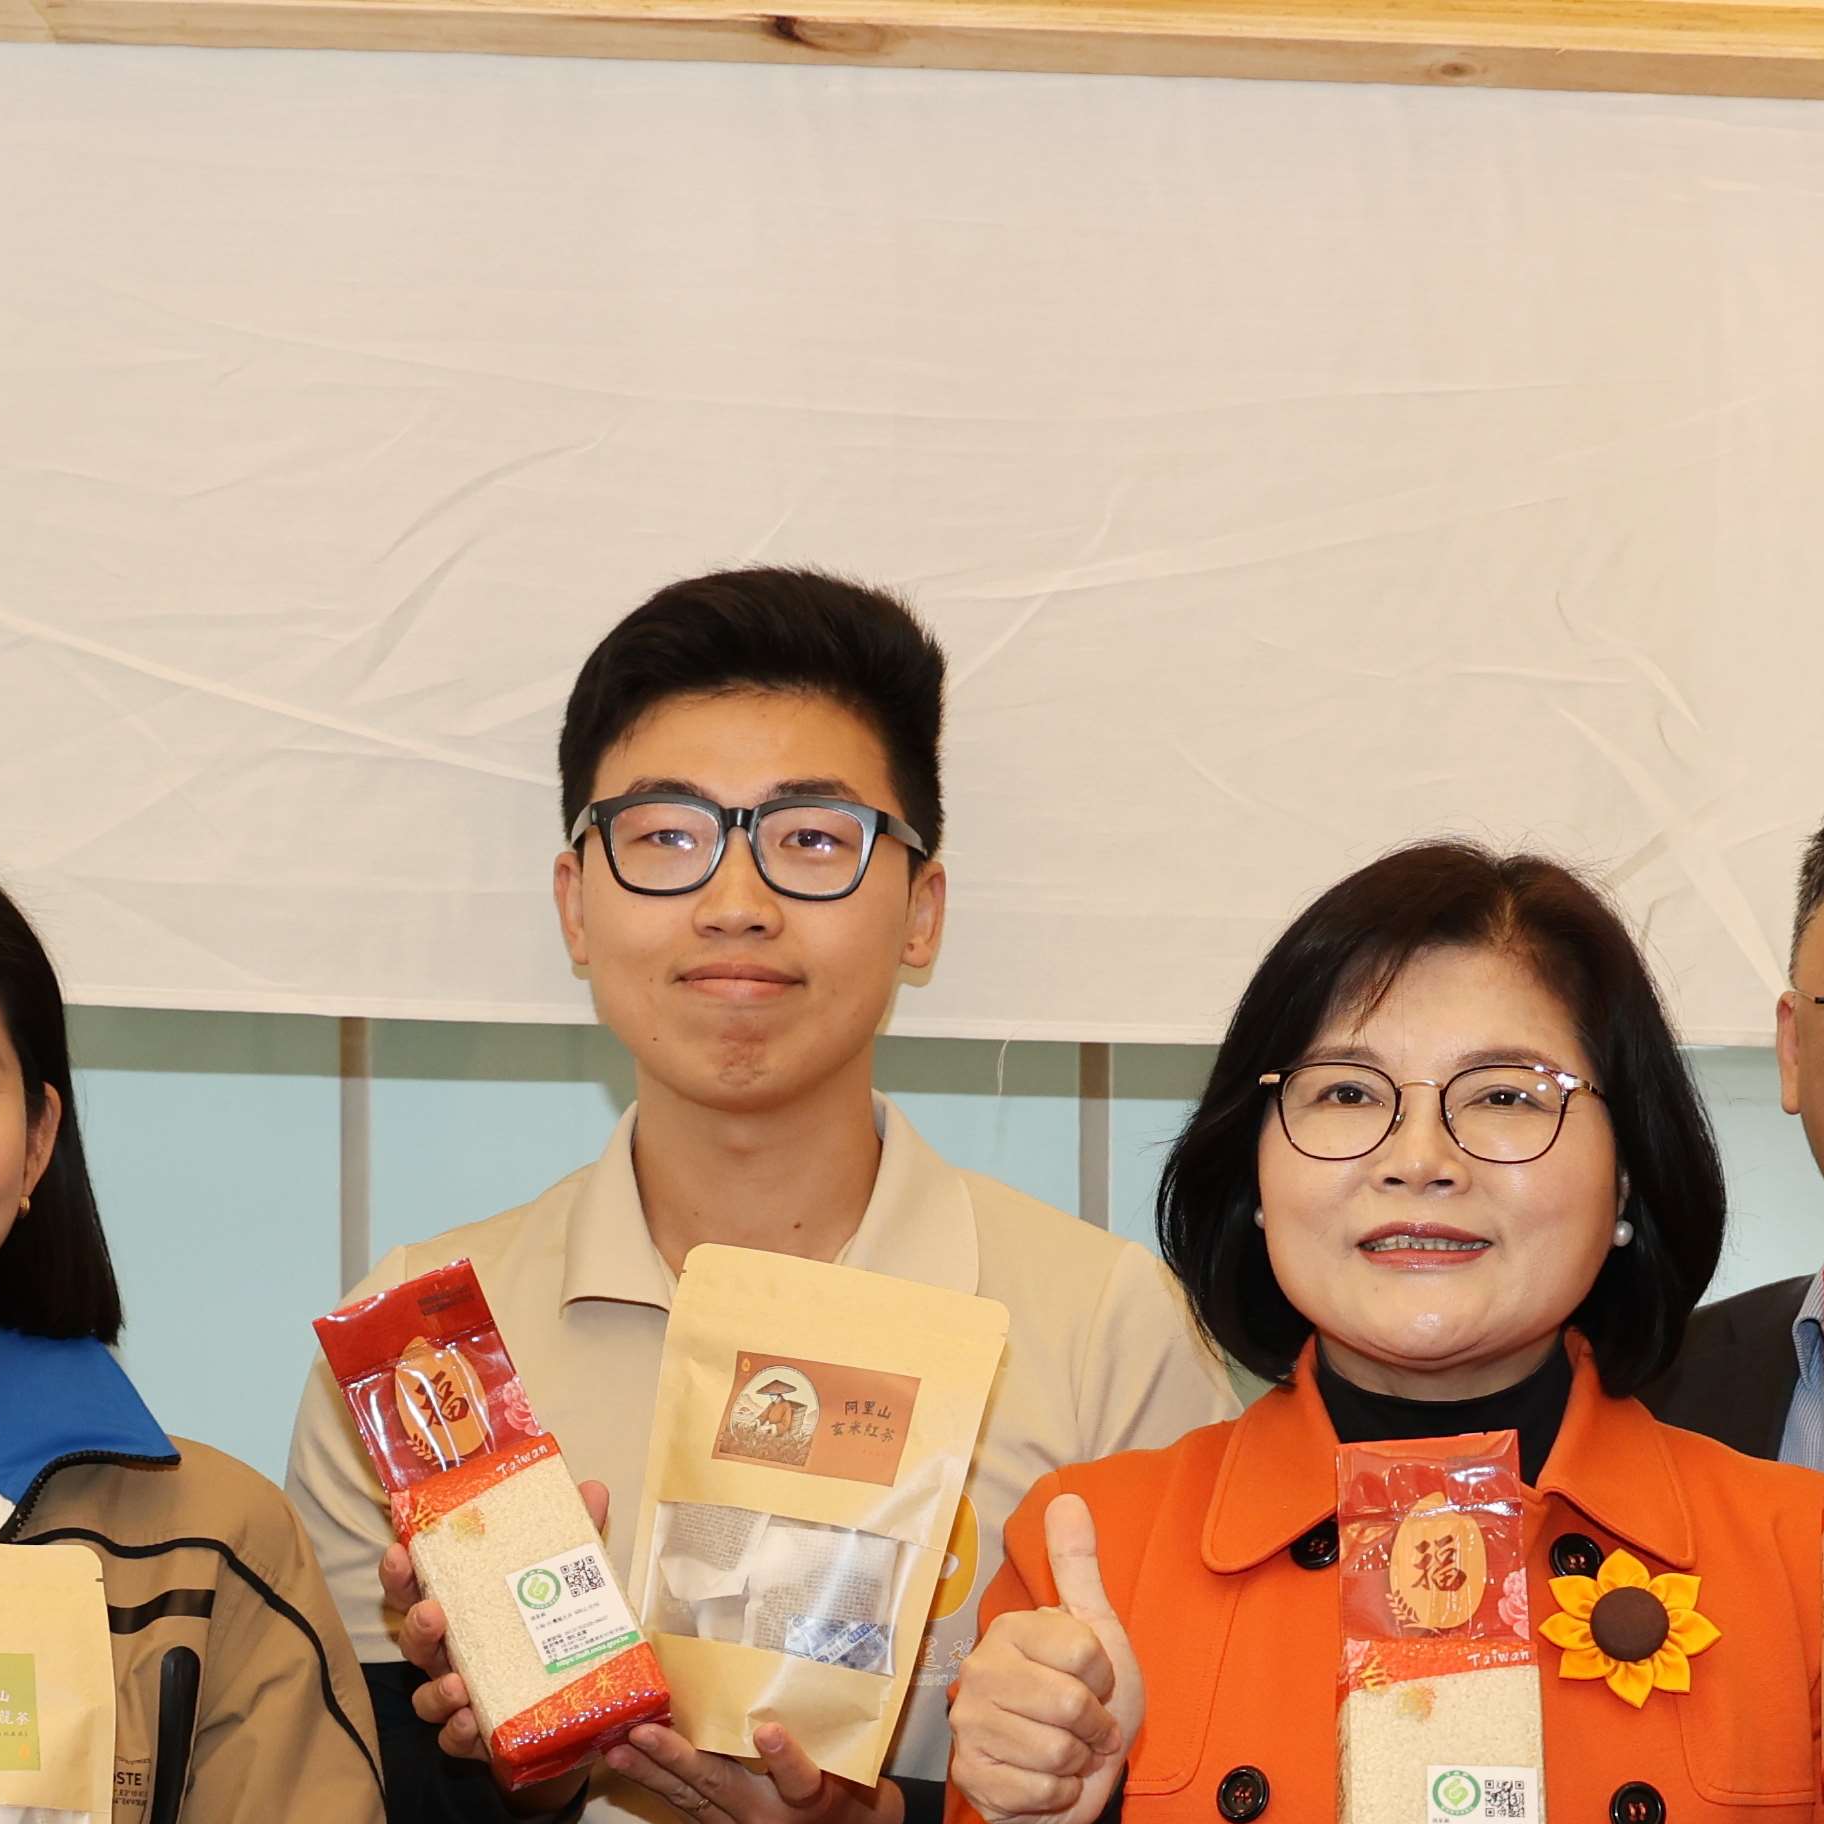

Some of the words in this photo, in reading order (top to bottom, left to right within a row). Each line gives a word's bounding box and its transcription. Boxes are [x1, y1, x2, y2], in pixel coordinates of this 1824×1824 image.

[414, 1370, 469, 1426] 福
[496, 1444, 550, 1477] Taiwan
[1411, 1538, 1467, 1592] 福
[1467, 1648, 1530, 1667] Taiwan
[112, 1771, 142, 1786] STE
